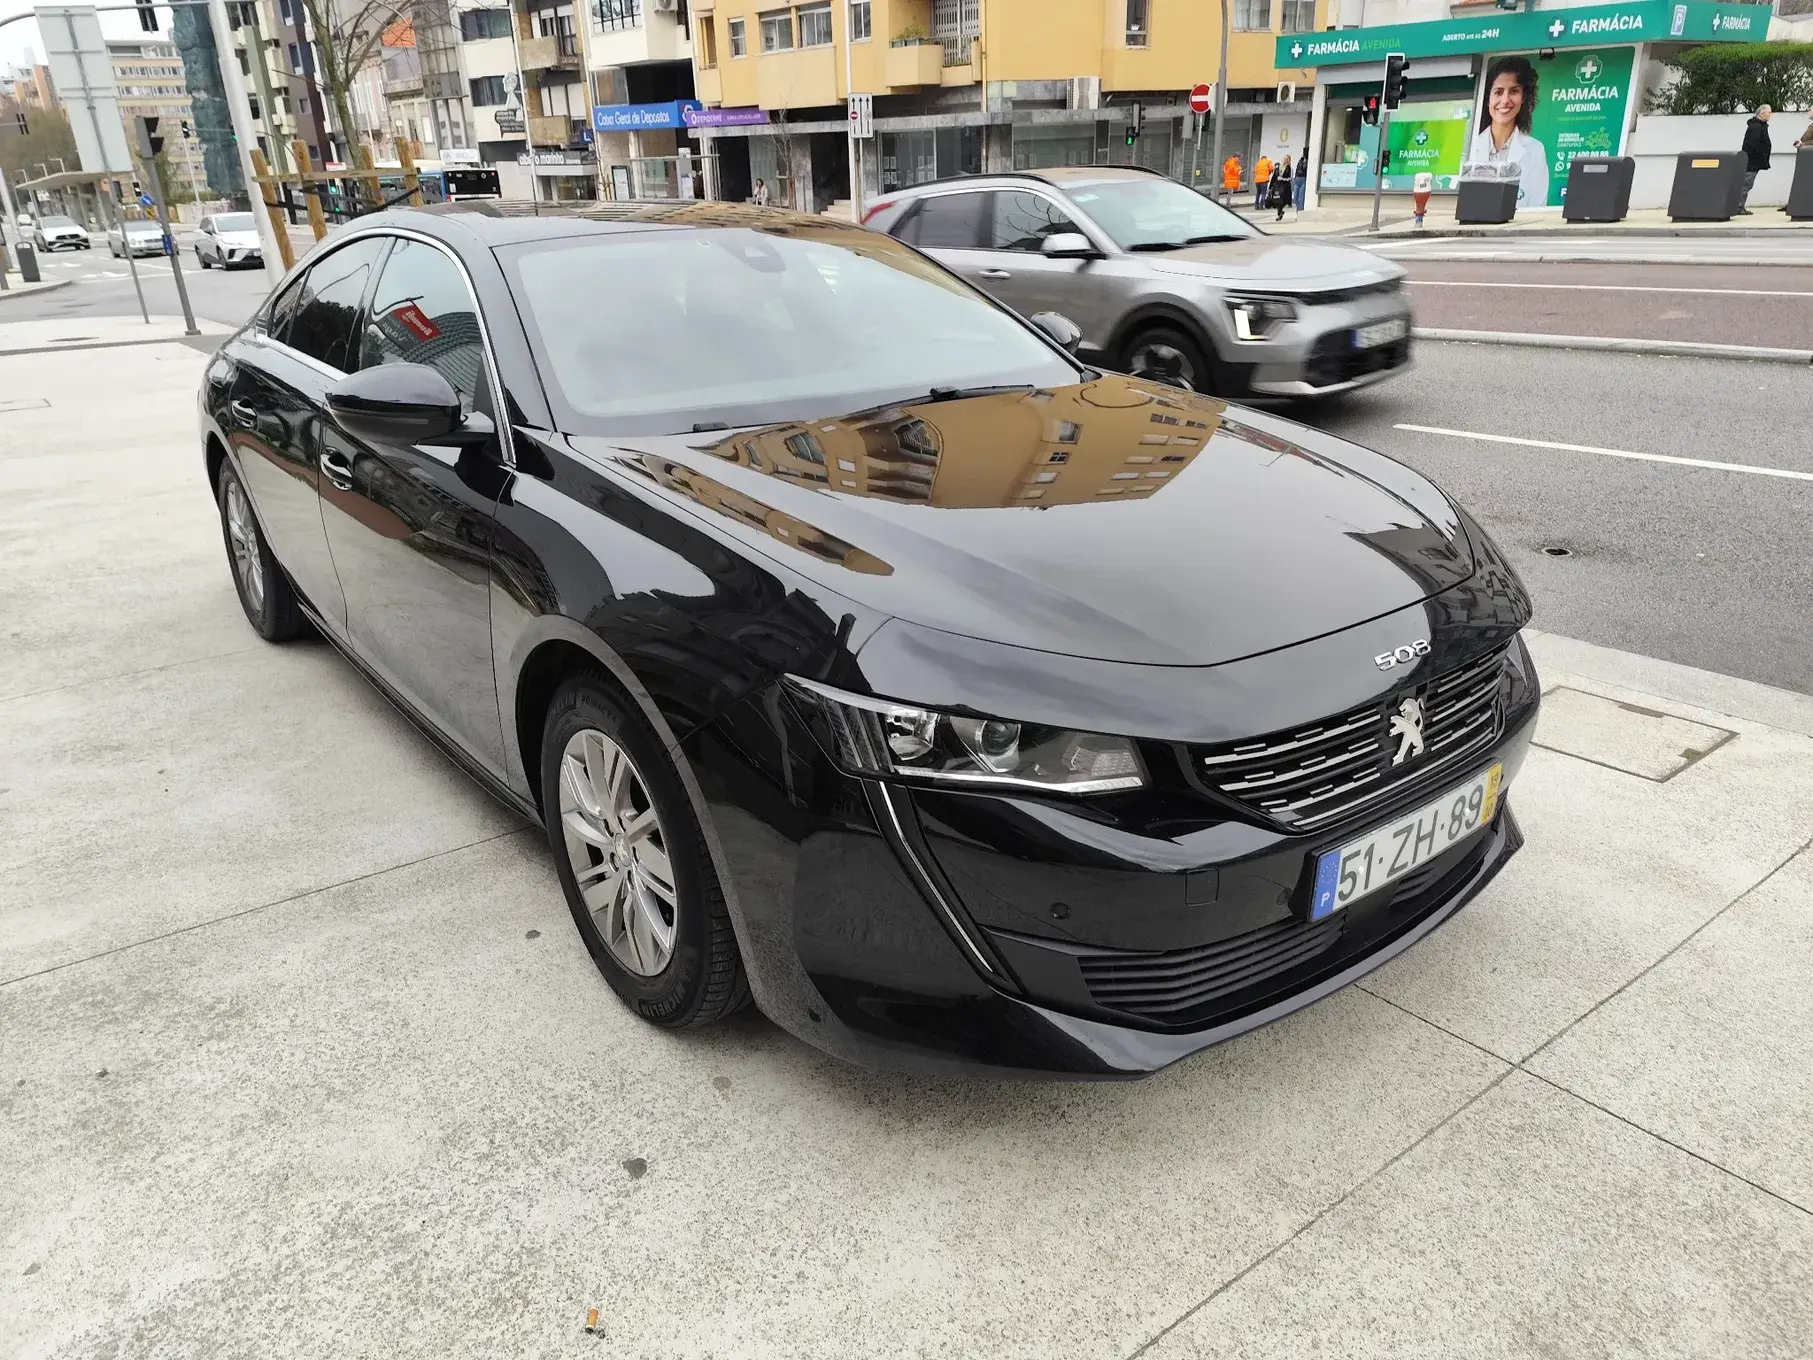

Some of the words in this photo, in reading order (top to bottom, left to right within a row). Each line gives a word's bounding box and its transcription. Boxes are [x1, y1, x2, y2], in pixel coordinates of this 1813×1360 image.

[1572, 13, 1643, 35] FARMÁCIA
[1722, 14, 1751, 31] FARMÁCIA
[1442, 32, 1466, 42] ABERTO
[1481, 28, 1500, 39] 24H
[1307, 38, 1360, 56] FARMÁCIA
[1361, 38, 1401, 52] AVENIDA
[1552, 85, 1619, 101] FARMÁCIA
[1565, 103, 1601, 112] AVENIDA
[598, 112, 614, 126] Caixa
[615, 111, 632, 125] Geral
[632, 111, 640, 124] de
[1399, 149, 1440, 158] FARMÁCIA
[1374, 639, 1431, 671] 508
[581, 695, 612, 718] PRIMACY
[1320, 893, 1331, 907] P
